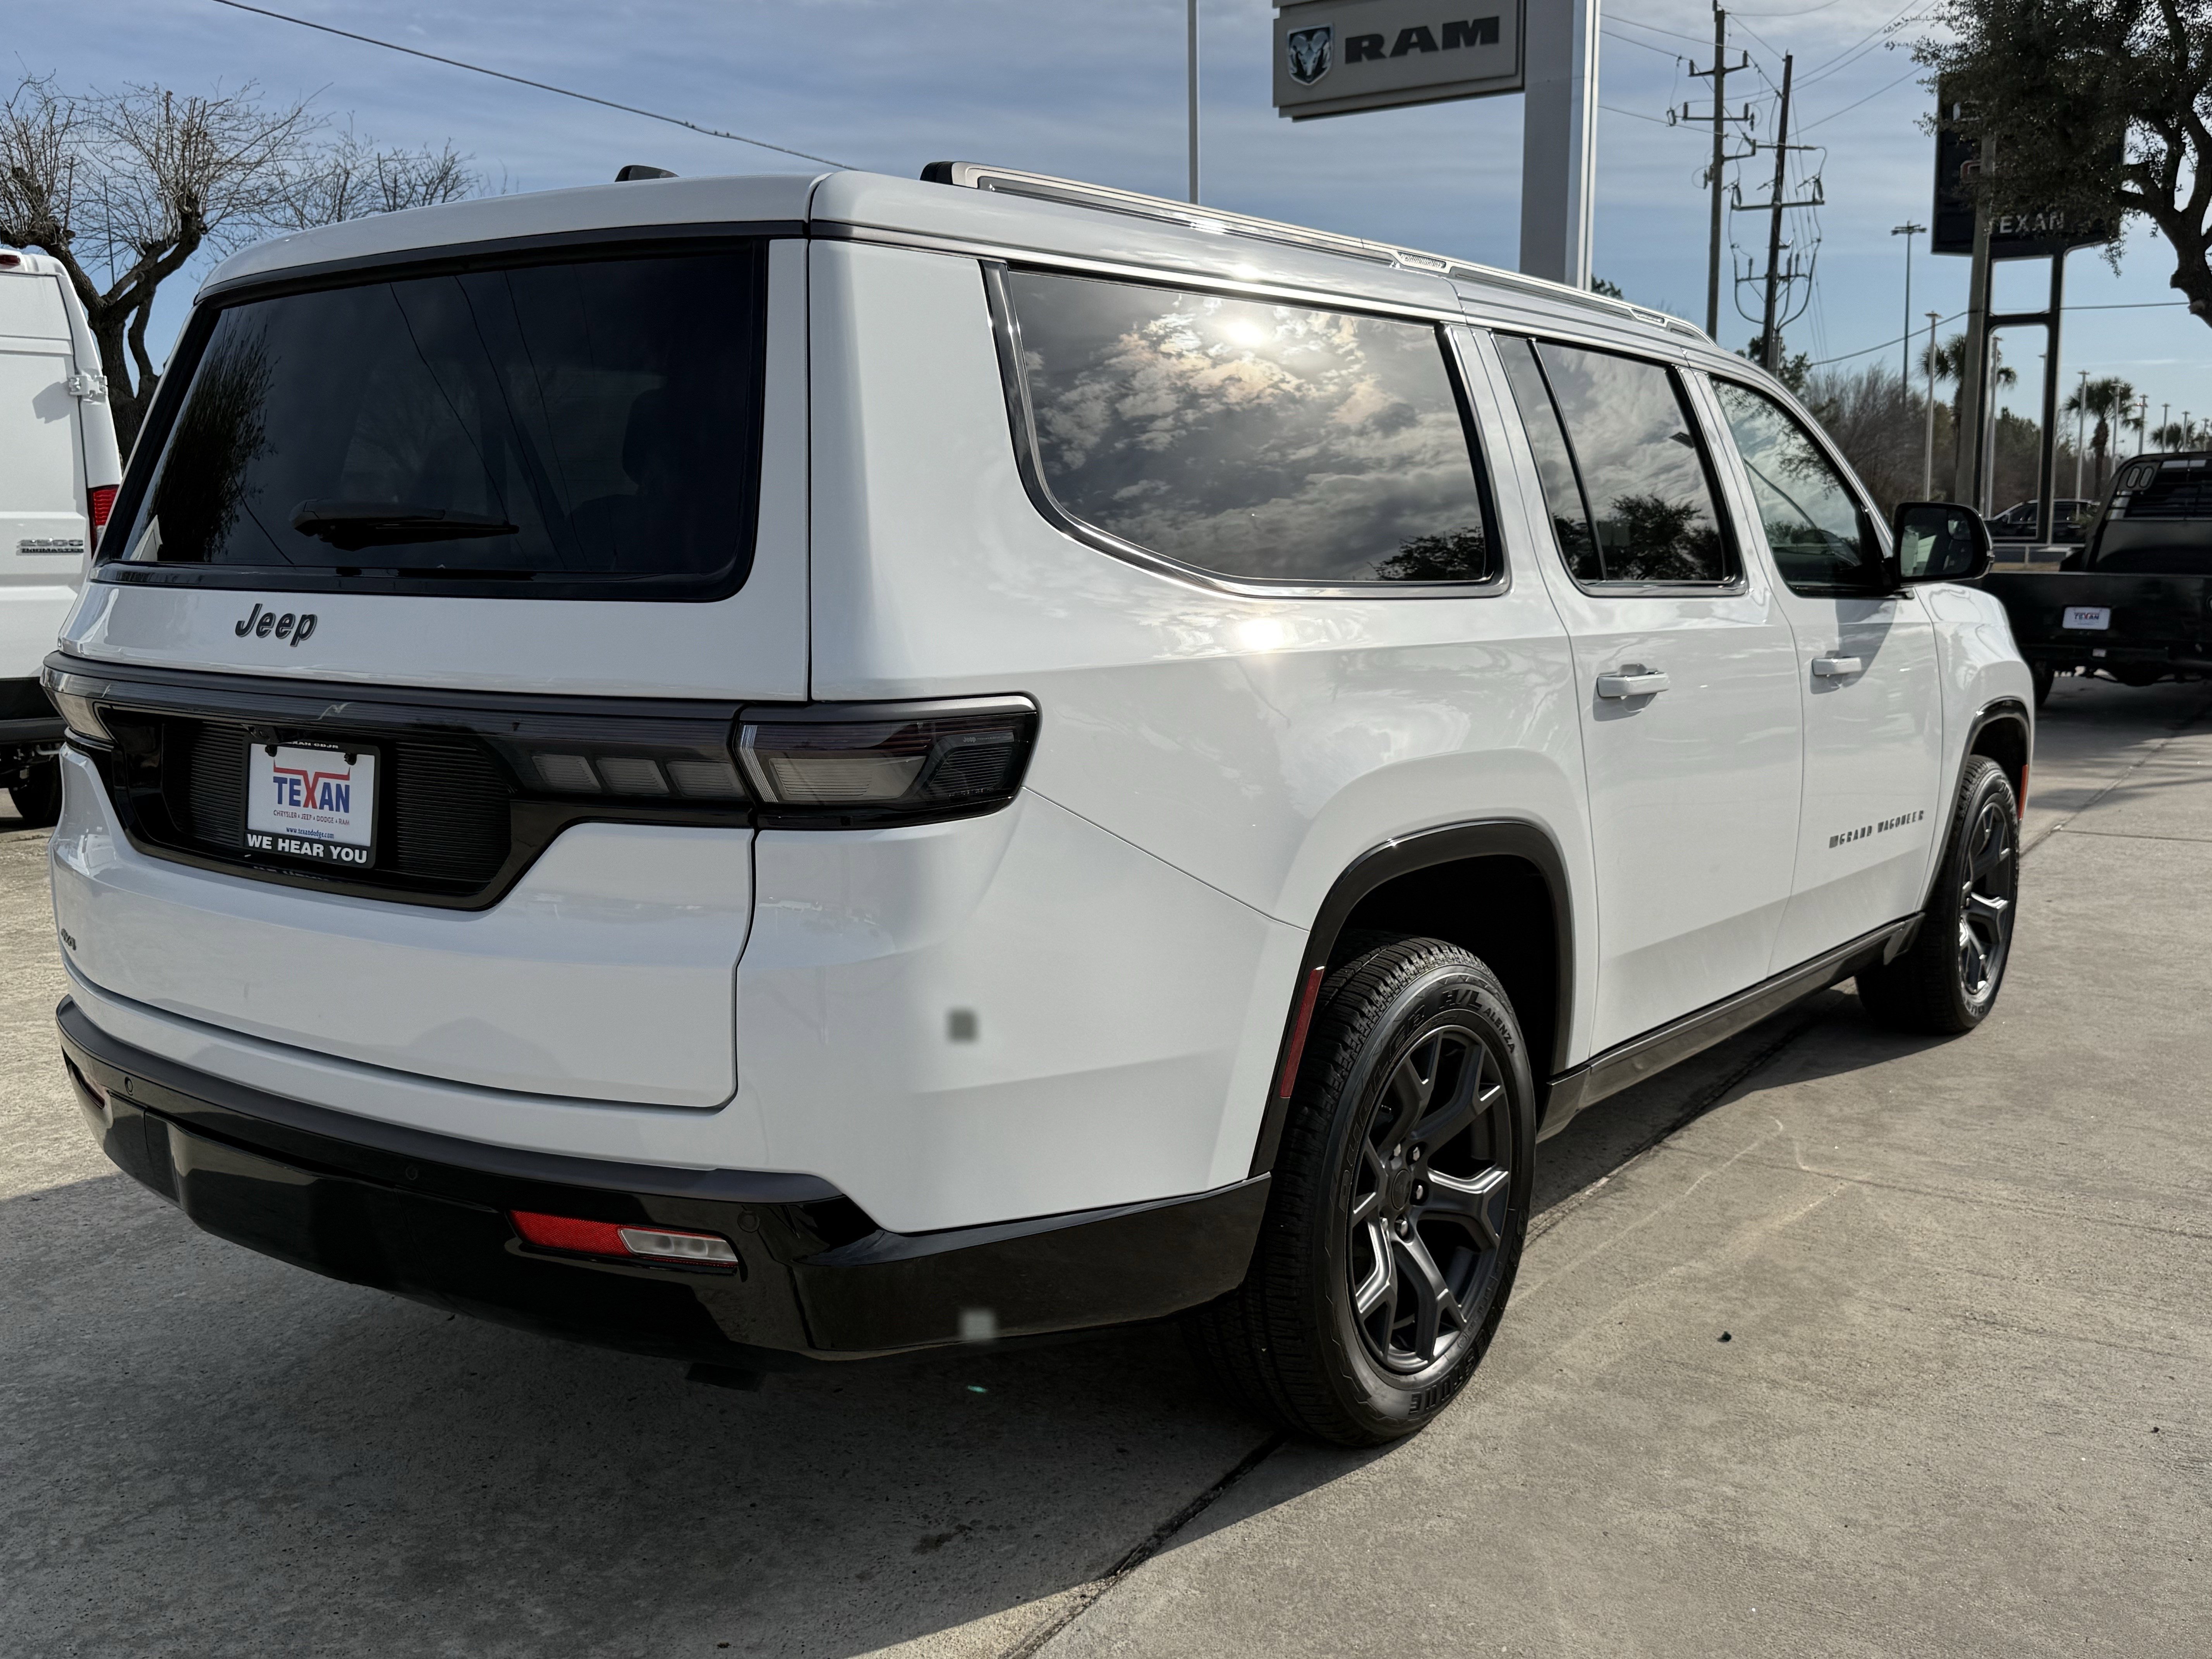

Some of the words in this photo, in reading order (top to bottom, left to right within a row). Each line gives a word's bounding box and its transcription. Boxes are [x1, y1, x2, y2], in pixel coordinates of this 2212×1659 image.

[1345, 16, 1499, 64] RAM
[1999, 212, 2064, 234] EXAN
[235, 603, 318, 647] Jeep
[273, 768, 350, 813] TEXAN
[316, 816, 334, 824] DODGE
[1839, 825, 1872, 845] GRAND
[1877, 810, 1924, 833] WAGONEER
[247, 834, 272, 849] WE
[277, 838, 324, 857] HEAR
[330, 845, 367, 864] YOU
[1483, 1008, 1515, 1054] ALENZA
